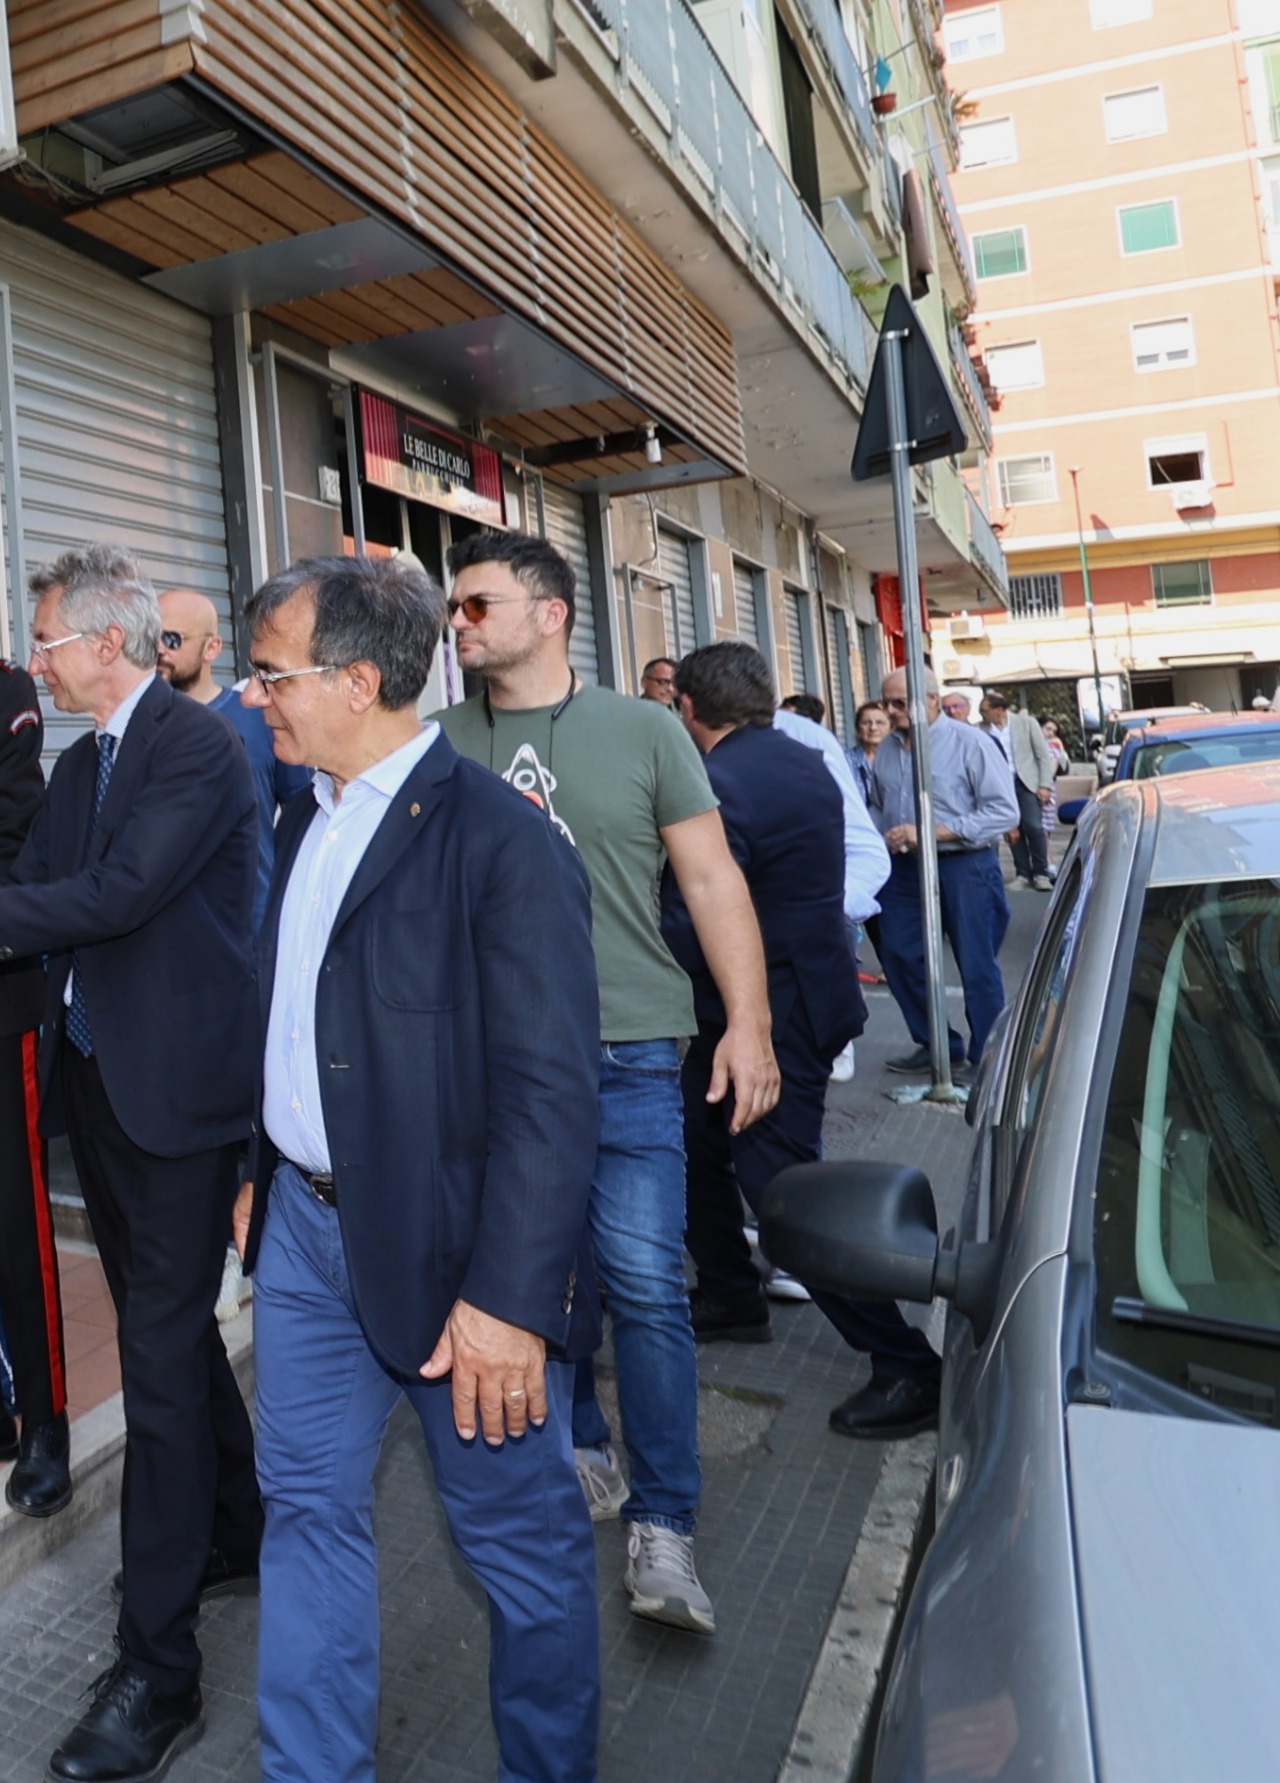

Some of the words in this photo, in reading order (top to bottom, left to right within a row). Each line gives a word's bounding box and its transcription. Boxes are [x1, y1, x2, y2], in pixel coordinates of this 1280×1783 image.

[403, 433, 414, 456] LE
[414, 438, 438, 466] BELLE
[438, 448, 447, 469] DI
[447, 452, 470, 479] CARLO
